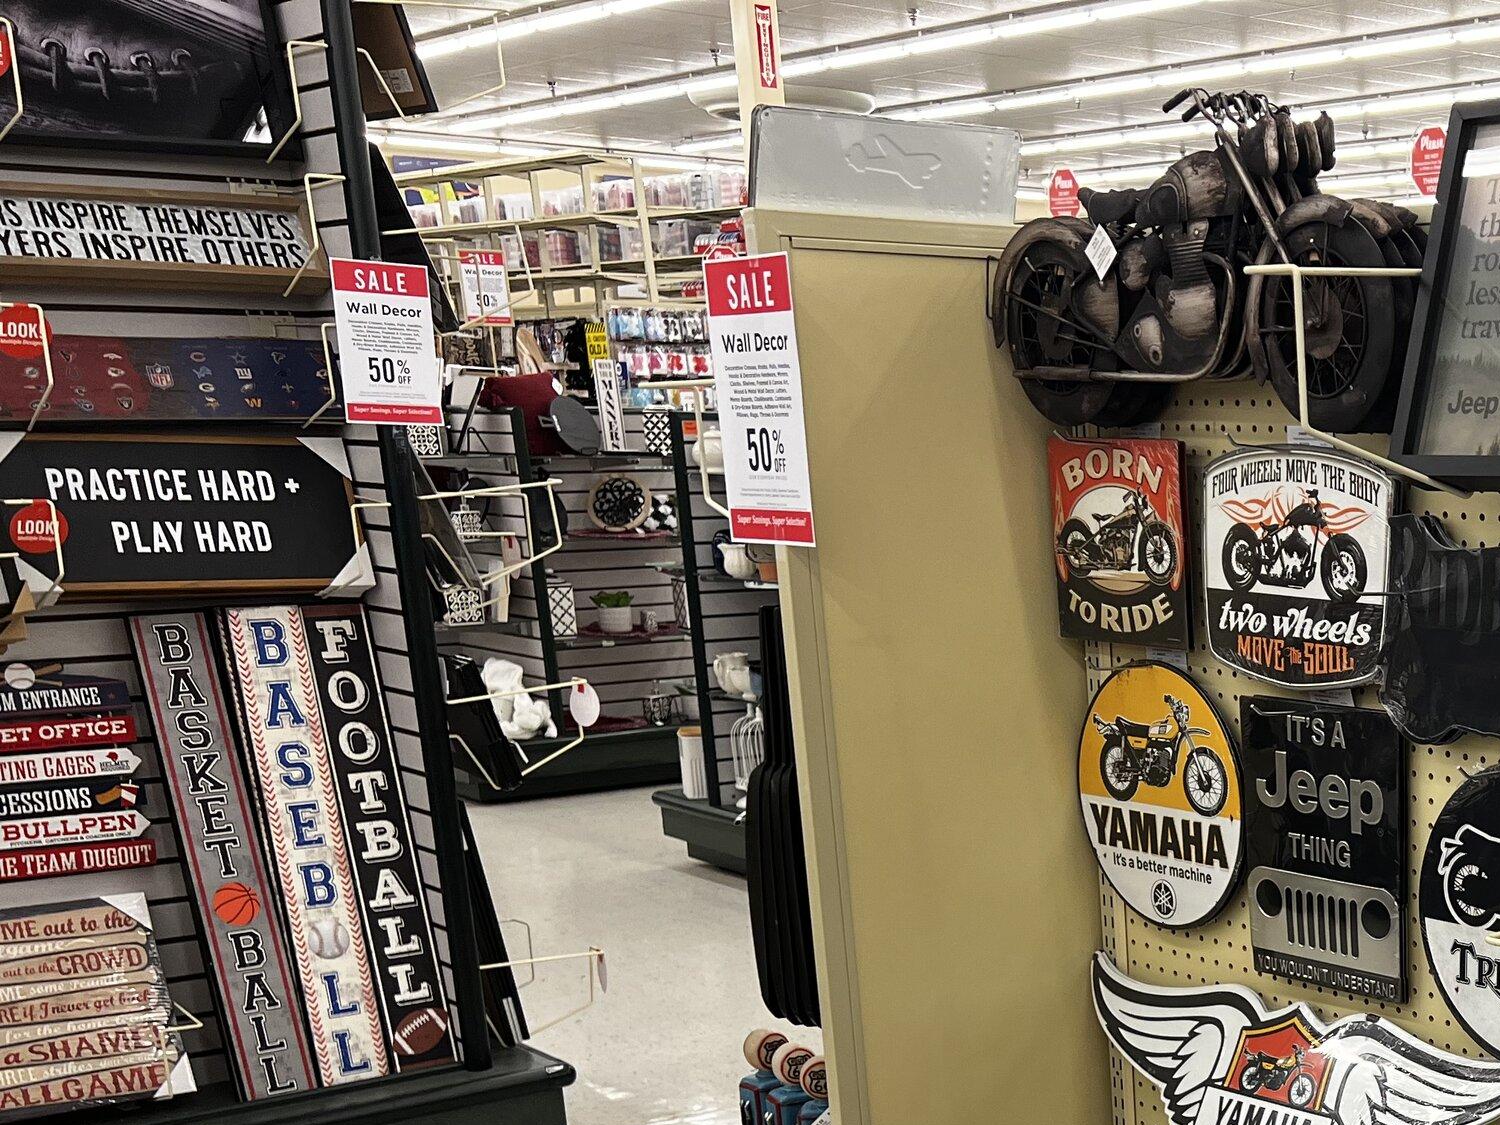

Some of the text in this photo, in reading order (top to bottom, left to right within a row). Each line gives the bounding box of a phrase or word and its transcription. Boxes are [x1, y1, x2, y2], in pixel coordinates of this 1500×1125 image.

[28, 201, 296, 242] INSPIRE THEMSELVES
[79, 233, 306, 268] INSPIRE OTHERS
[355, 268, 408, 294] SALE
[727, 271, 775, 310] SALE
[346, 301, 422, 318] Wall Decor
[721, 332, 788, 353] Wall Decor
[1448, 389, 1500, 419] Jeep
[45, 468, 276, 501] PRACTICE HARD
[1060, 448, 1165, 494] BORN
[1212, 458, 1382, 508] FOUR WHEELS MOVE THE BODY
[111, 520, 272, 553] PLAY HARD
[1067, 589, 1175, 634] TO RIDE
[1219, 598, 1373, 647] two wheels
[1237, 635, 1355, 676] MOVE SOUL
[21, 686, 102, 711] ENTRANCE
[38, 720, 127, 740] OFFICE
[1285, 714, 1347, 750] IT'S A
[43, 754, 97, 778] CAGES
[153, 622, 240, 879] BASKET
[1256, 751, 1384, 835] Jeep
[1, 813, 138, 841] BULLPEN
[314, 619, 434, 1007] FOOTBALL
[1089, 803, 1230, 870] YAMAHA
[1287, 832, 1351, 868] THING
[22, 844, 152, 875] TEAM DUGOUT
[1136, 858, 1212, 885] better machine
[57, 947, 143, 976] CROWD
[1258, 954, 1397, 999] YOU WOULDN'T UNDERSTAND
[51, 1000, 91, 1015] never
